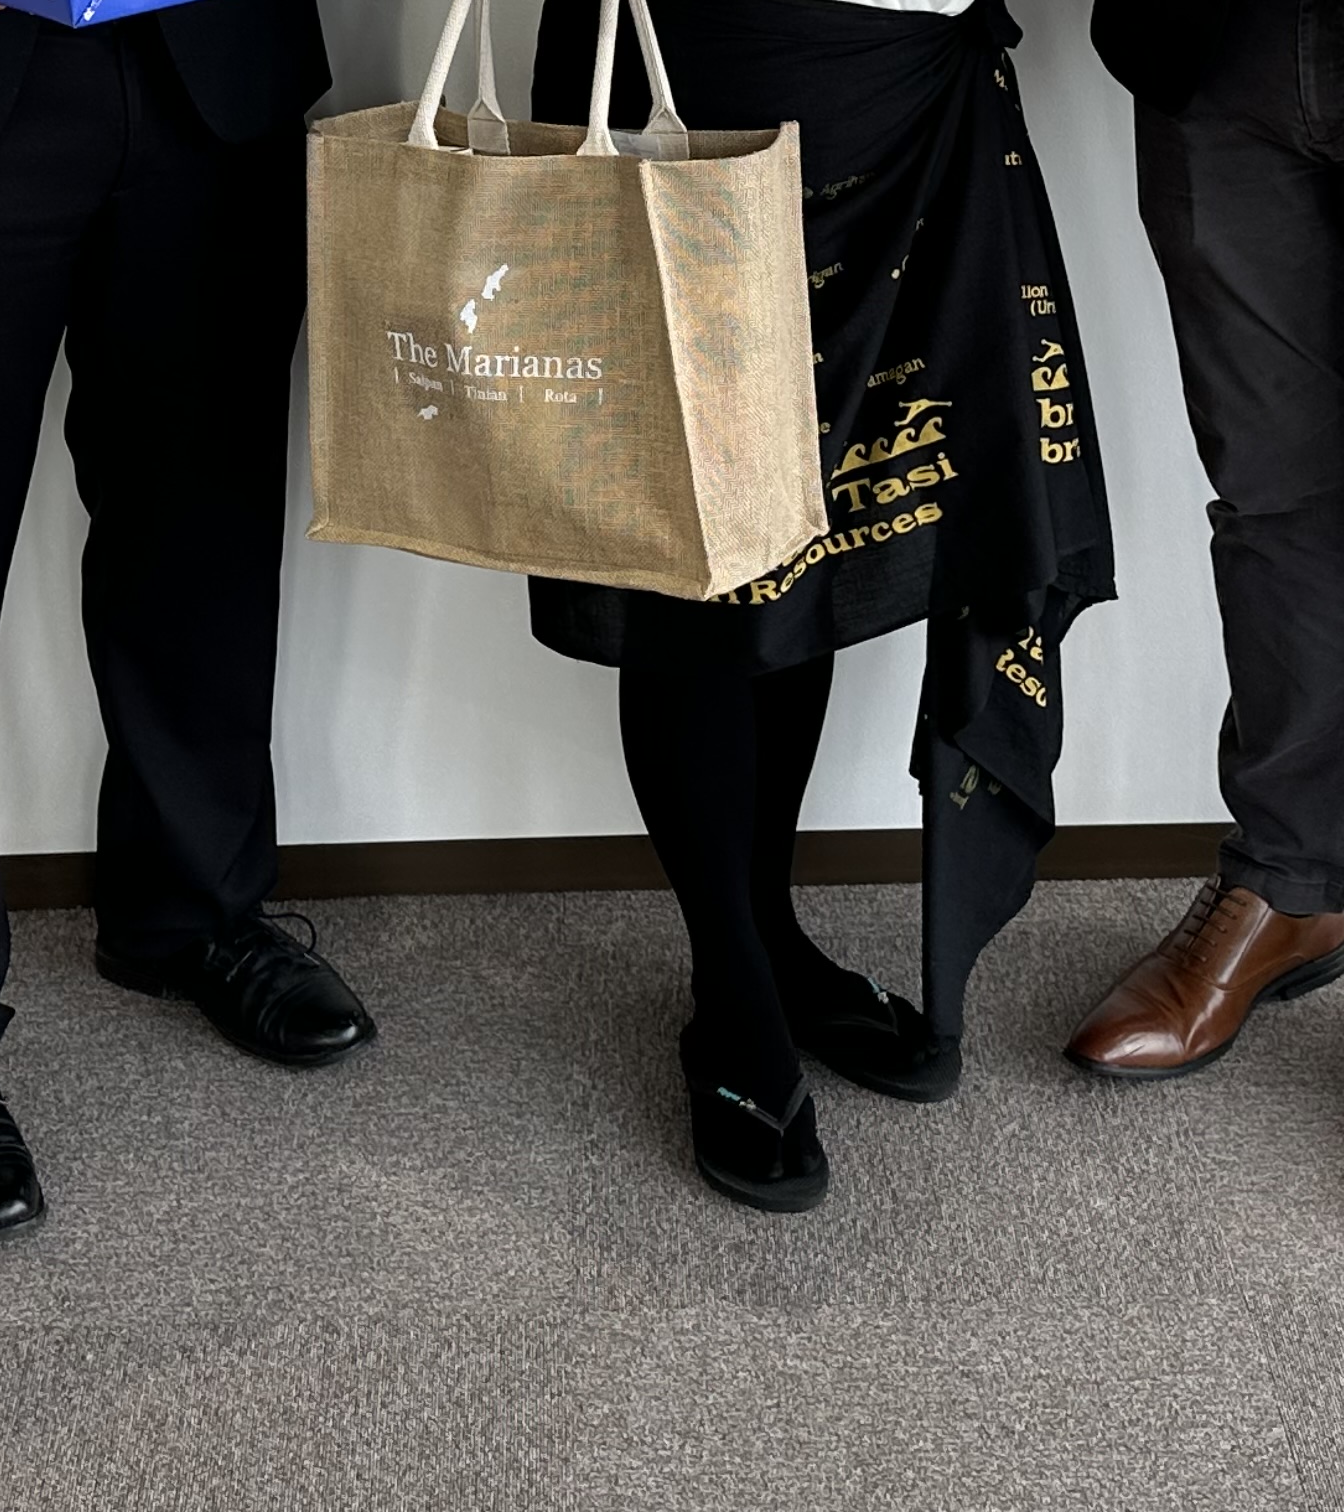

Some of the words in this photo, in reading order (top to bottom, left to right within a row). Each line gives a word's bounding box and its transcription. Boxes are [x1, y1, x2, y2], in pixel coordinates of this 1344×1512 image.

[386, 331, 438, 369] The
[444, 343, 603, 380] Marianas
[409, 371, 443, 392] Saipan
[464, 385, 507, 401] Tinian
[544, 388, 577, 403] Rota
[832, 452, 958, 513] Tasi
[749, 502, 943, 604] Resources
